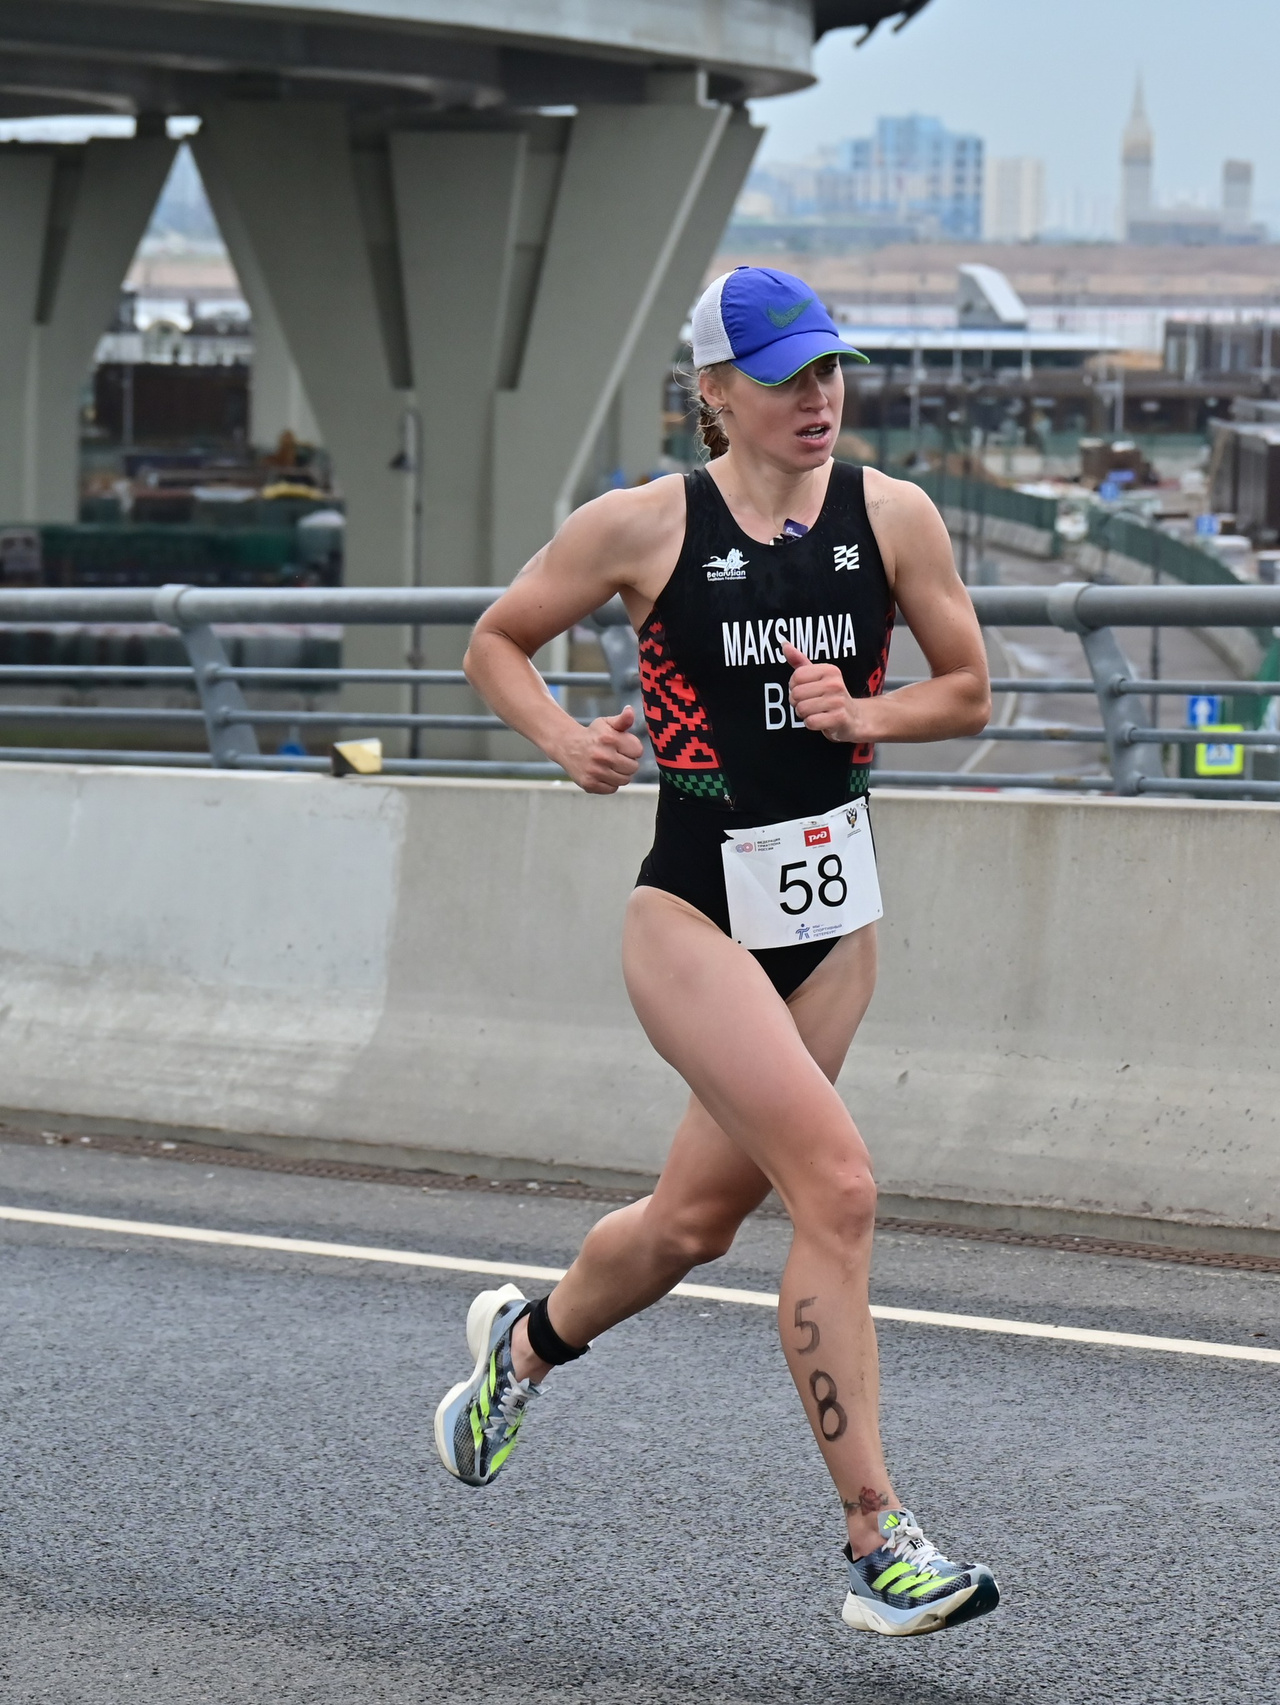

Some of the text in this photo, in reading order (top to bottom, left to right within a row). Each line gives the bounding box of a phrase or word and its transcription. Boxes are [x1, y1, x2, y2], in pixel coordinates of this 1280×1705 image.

[722, 613, 857, 667] MAKSIMAVA
[764, 682, 806, 730] BL
[779, 854, 848, 915] 58
